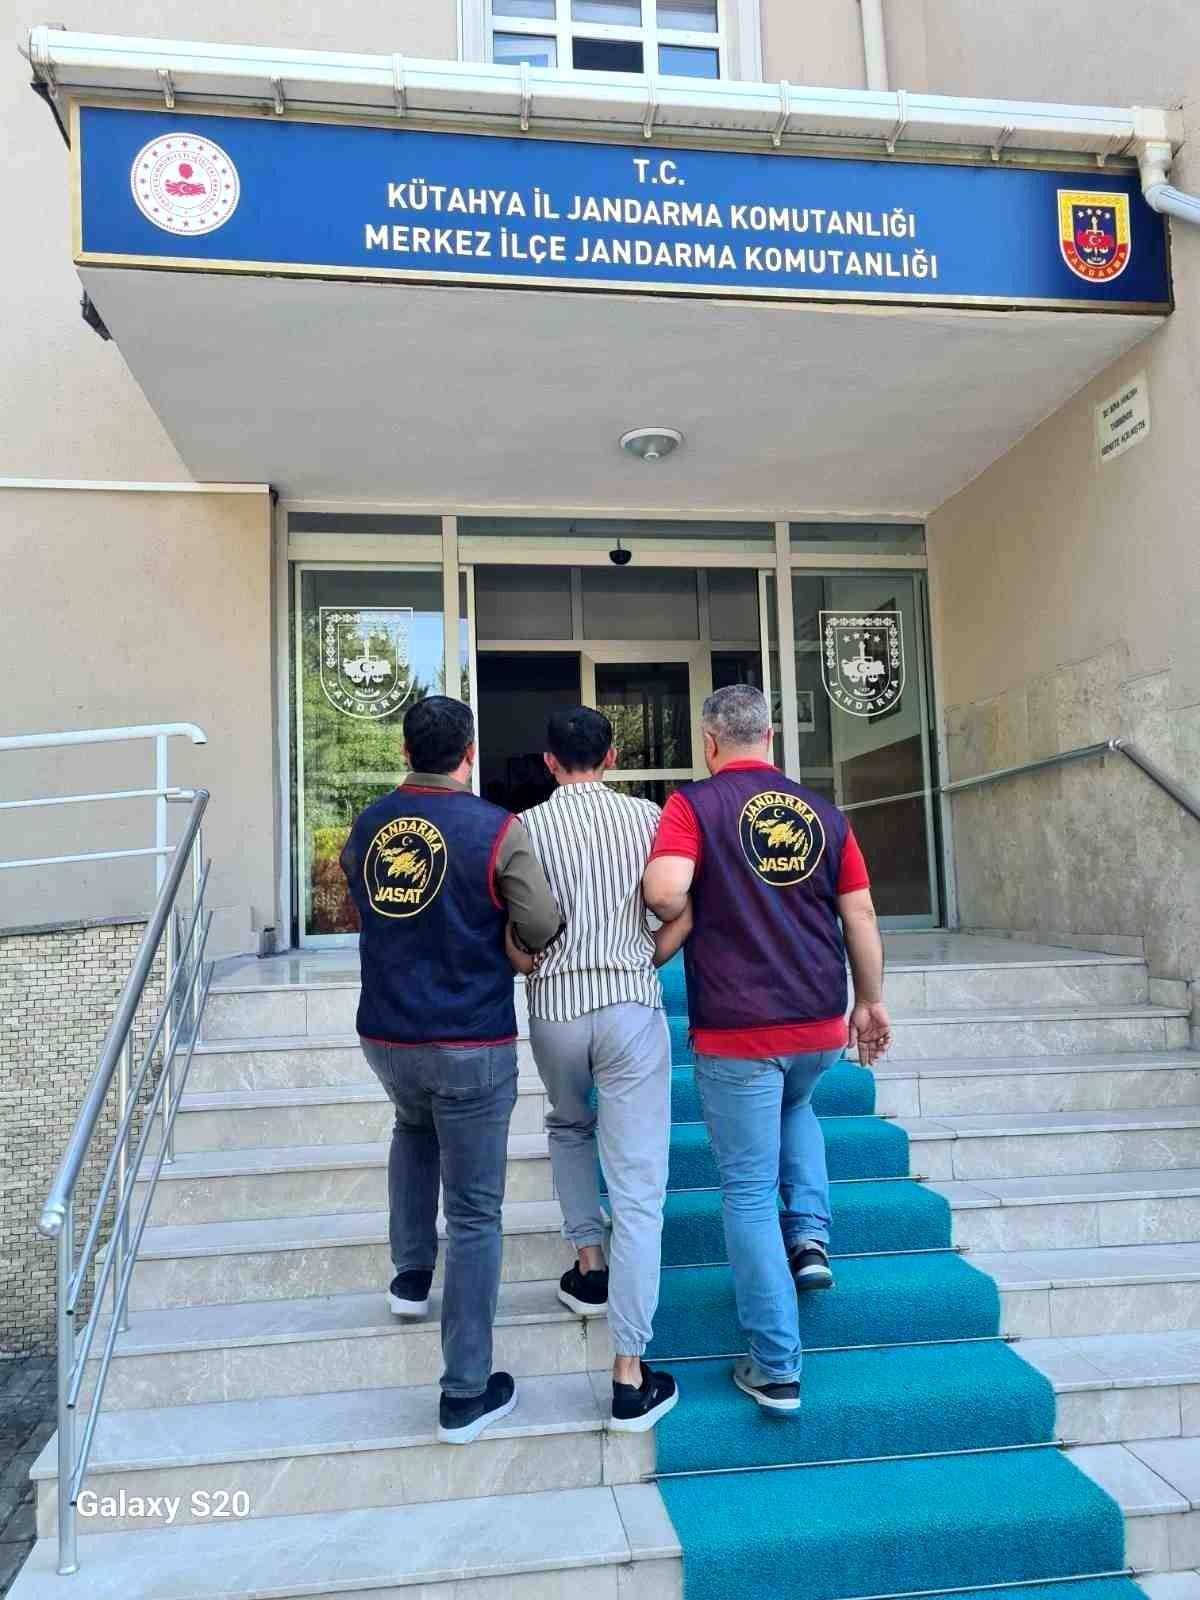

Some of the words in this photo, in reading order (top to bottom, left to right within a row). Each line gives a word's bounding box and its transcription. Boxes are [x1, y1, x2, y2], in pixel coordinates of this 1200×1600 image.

[633, 158, 685, 186] T.C.
[387, 178, 526, 217] KÜTAHYA
[533, 187, 560, 219] İL
[567, 195, 723, 228] JANDARMA
[730, 204, 917, 239] KOMUTANLIĞI
[365, 223, 491, 257] MERKEZ
[500, 227, 566, 264] İLÇE
[574, 237, 737, 270] JANDARMA
[745, 246, 938, 280] KOMUTANLIĞI
[328, 680, 407, 712] JANDARMA
[829, 680, 899, 710] JANDARMA
[744, 794, 815, 823] JANDARMA
[375, 820, 443, 855] JANDARMA
[759, 856, 806, 872] JASAT
[374, 886, 424, 904] JASAT
